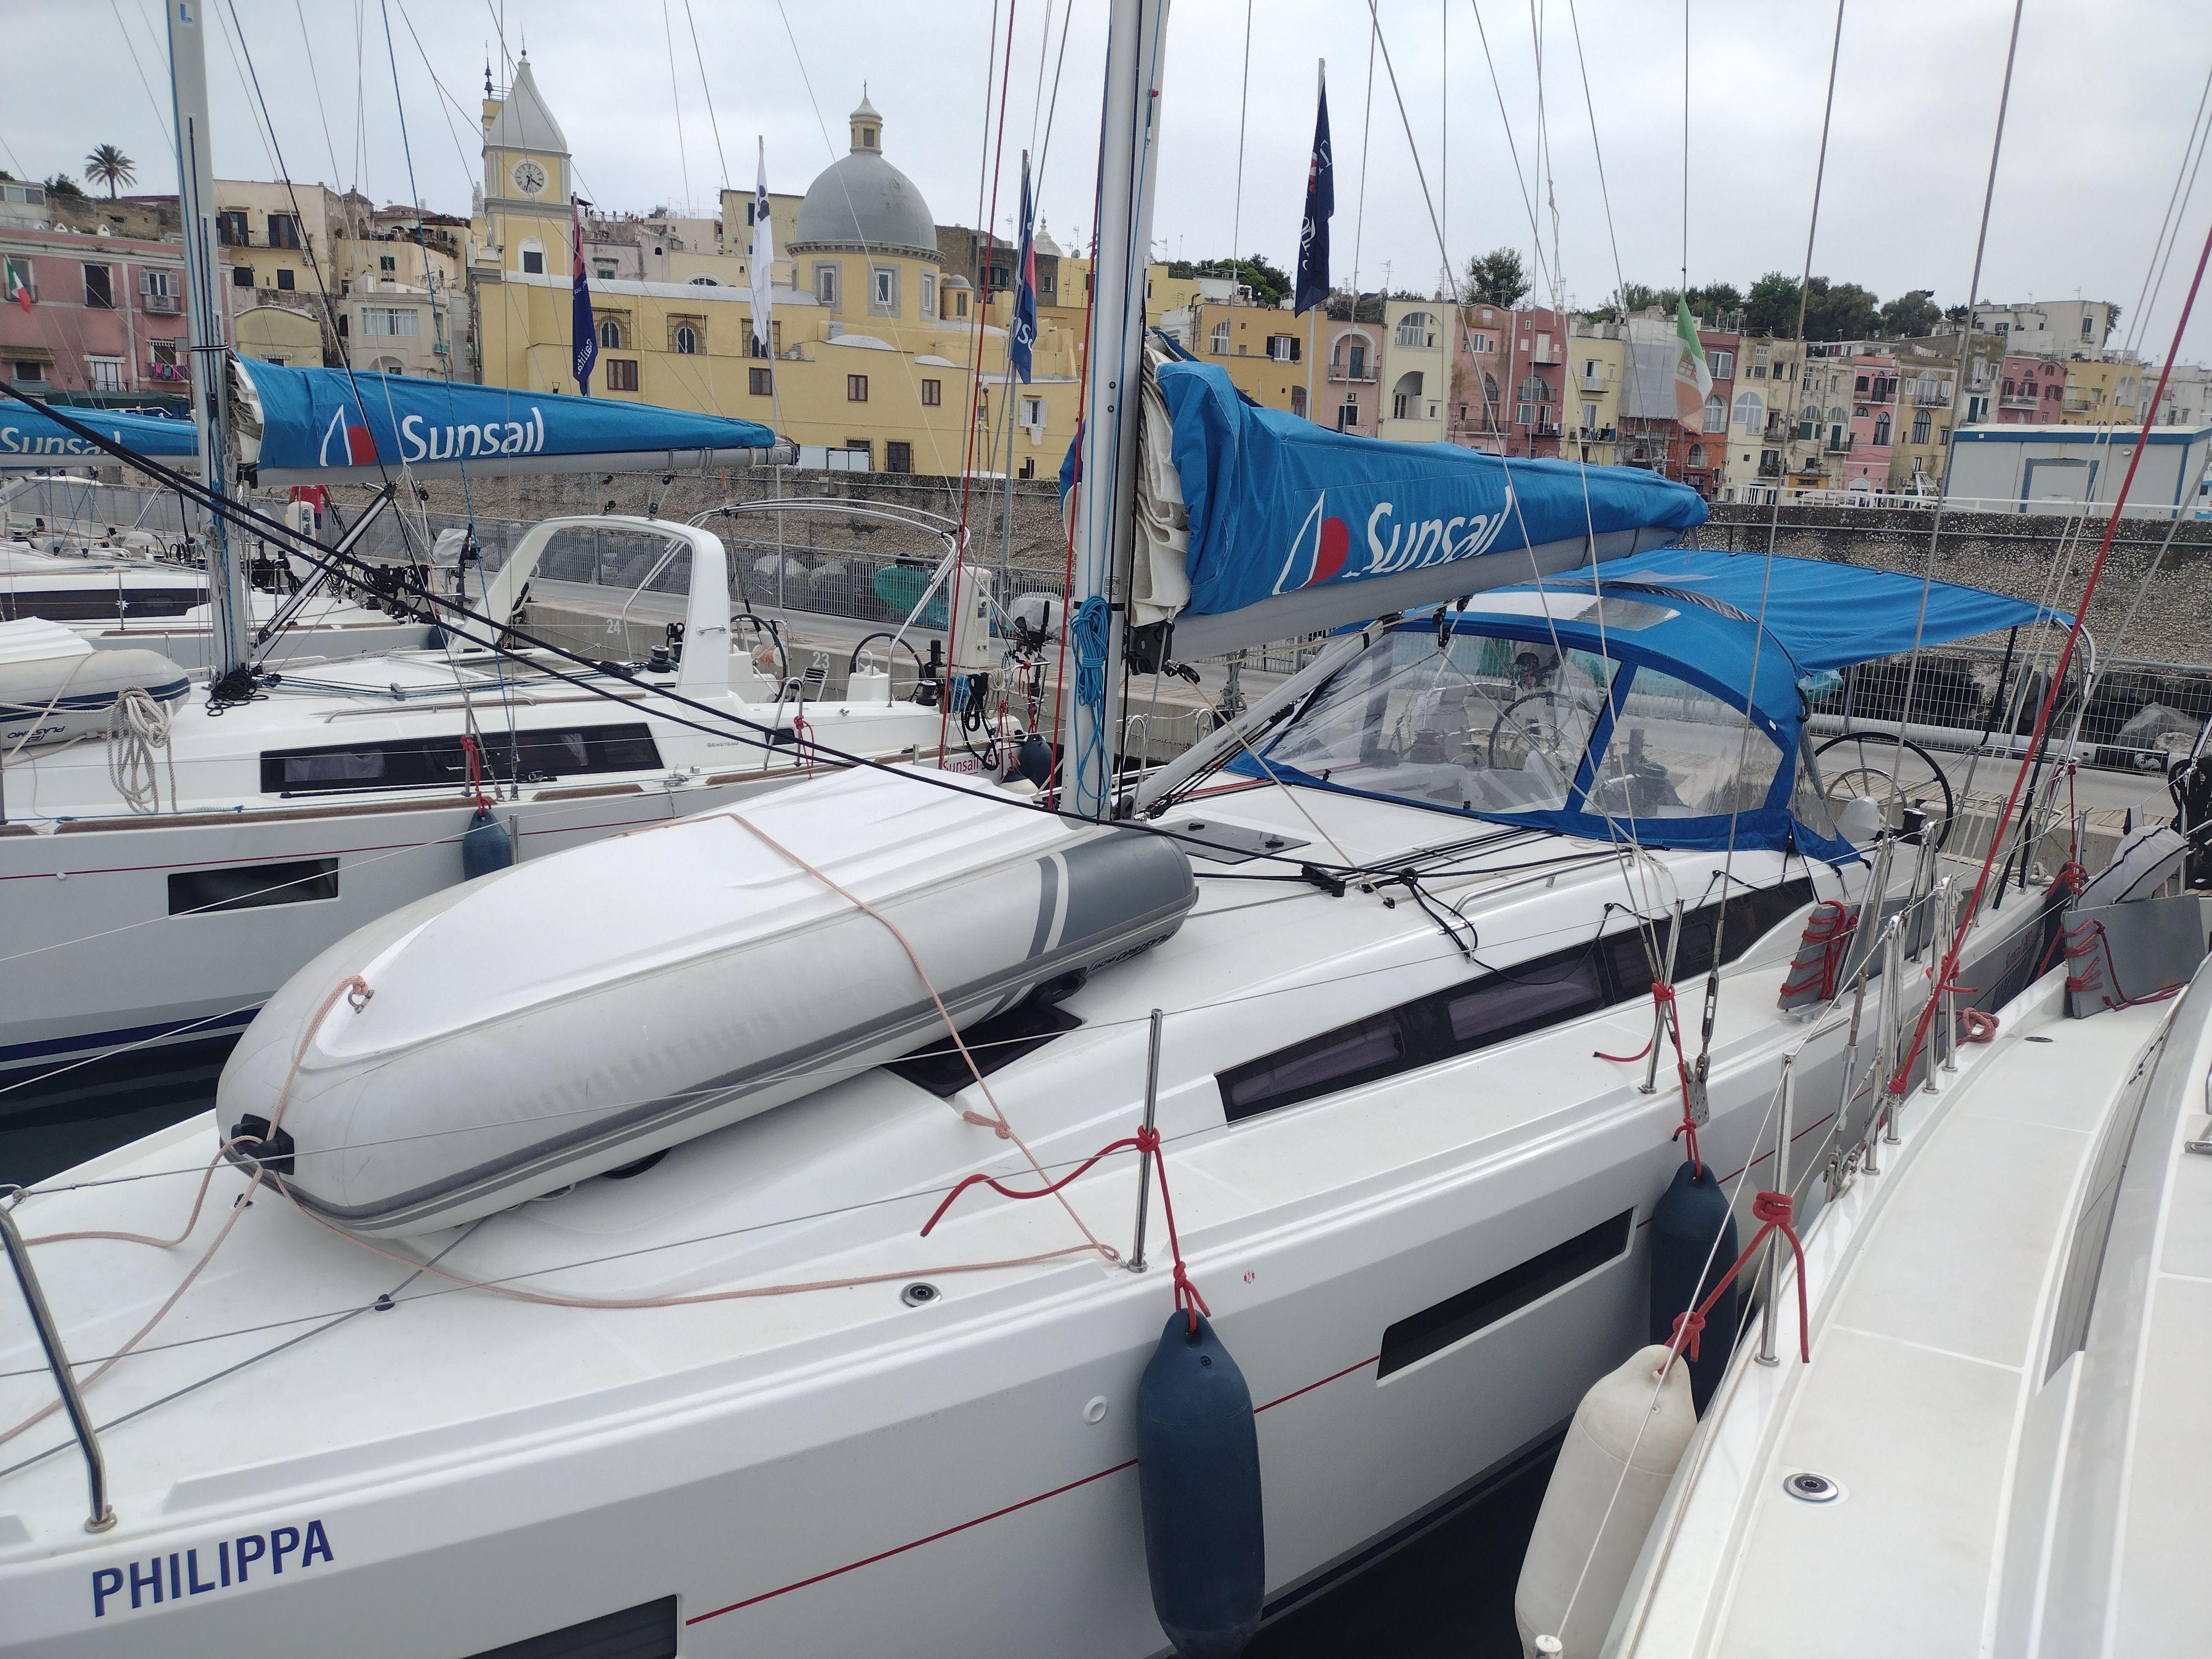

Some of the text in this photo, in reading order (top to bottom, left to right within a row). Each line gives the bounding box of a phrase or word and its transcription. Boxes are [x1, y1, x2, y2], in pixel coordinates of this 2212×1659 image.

[0, 427, 121, 455] Sunsa
[401, 406, 544, 462] Sunsail
[1342, 485, 1512, 578] Sunsail
[606, 619, 621, 635] 24
[812, 651, 830, 669] 23
[7, 726, 66, 739] PLASIMO
[943, 754, 979, 773] Sunsail
[92, 1519, 334, 1618] PHILIPPA
